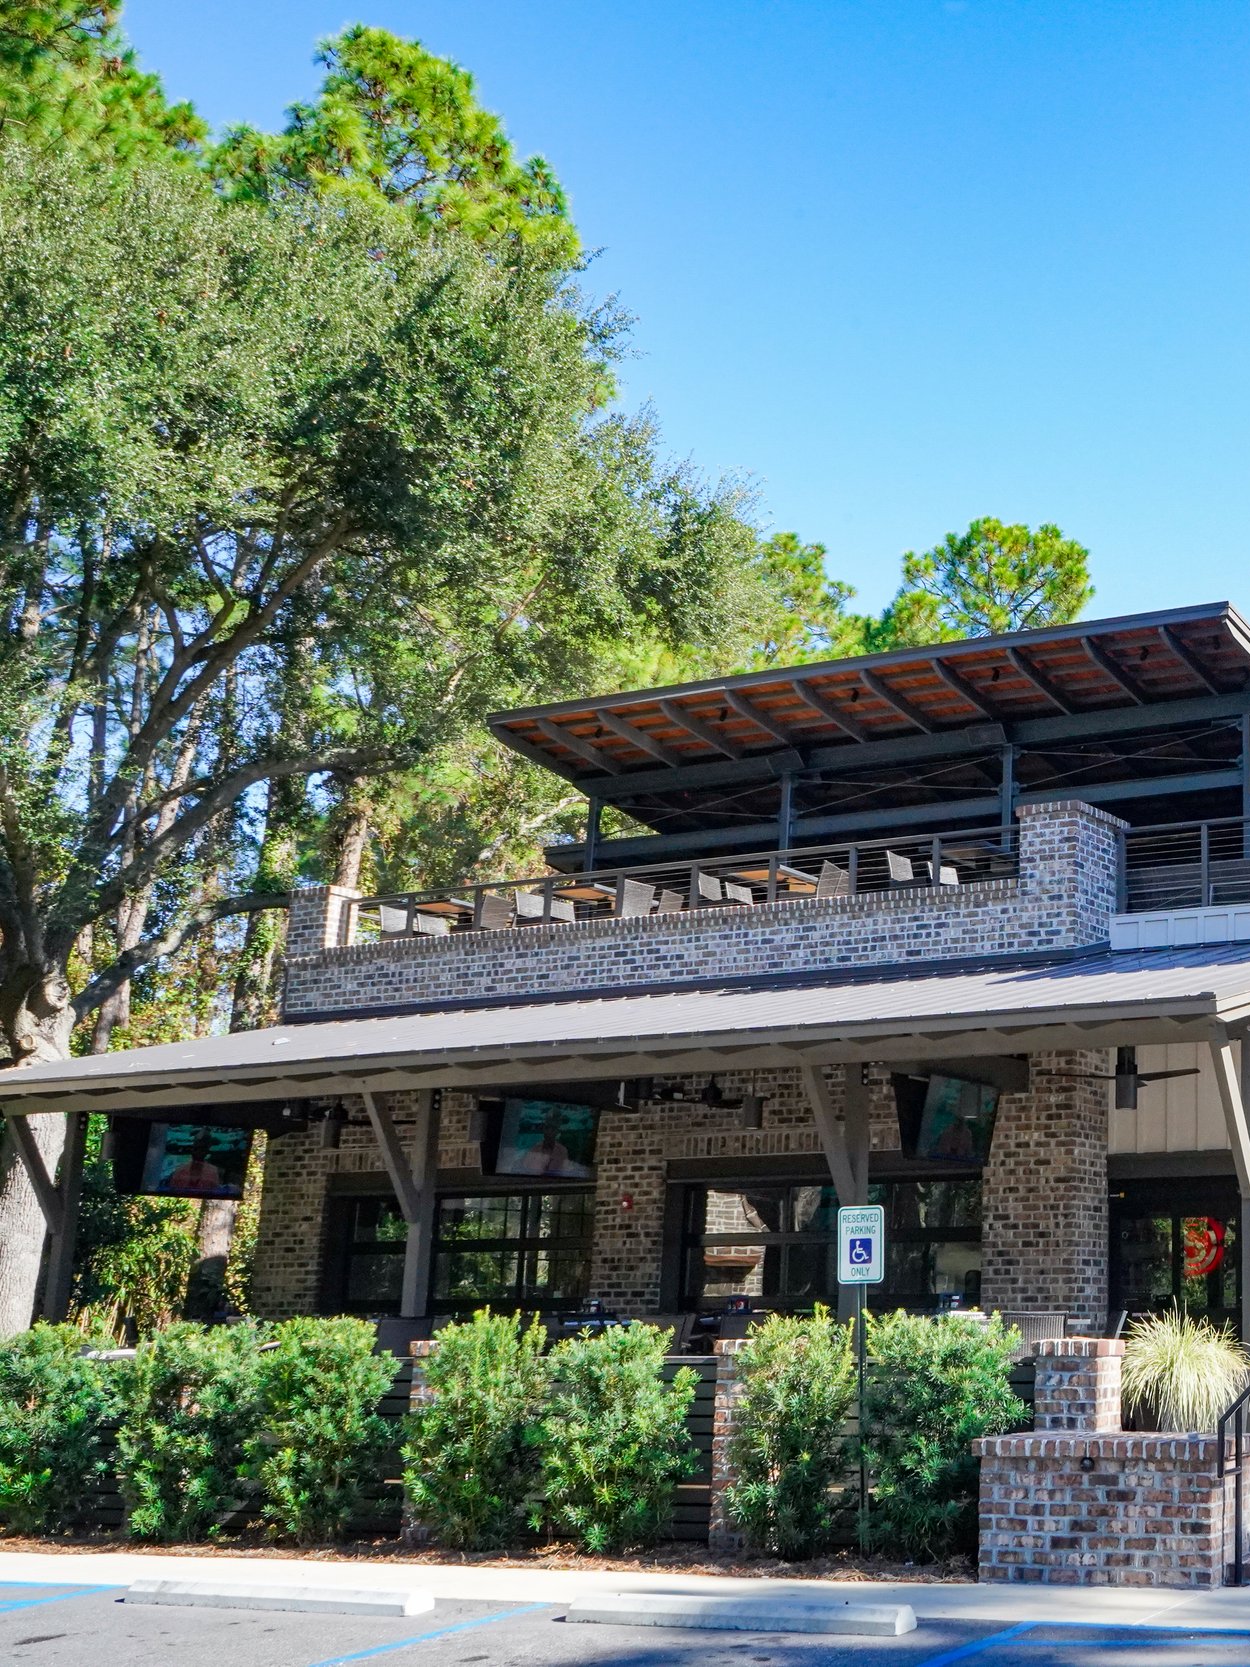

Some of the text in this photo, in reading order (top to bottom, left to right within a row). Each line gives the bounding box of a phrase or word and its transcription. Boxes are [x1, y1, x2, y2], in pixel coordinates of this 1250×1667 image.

[843, 1213, 879, 1223] RESERVED
[846, 1225, 876, 1235] PARKING
[851, 1267, 870, 1277] ONLY
